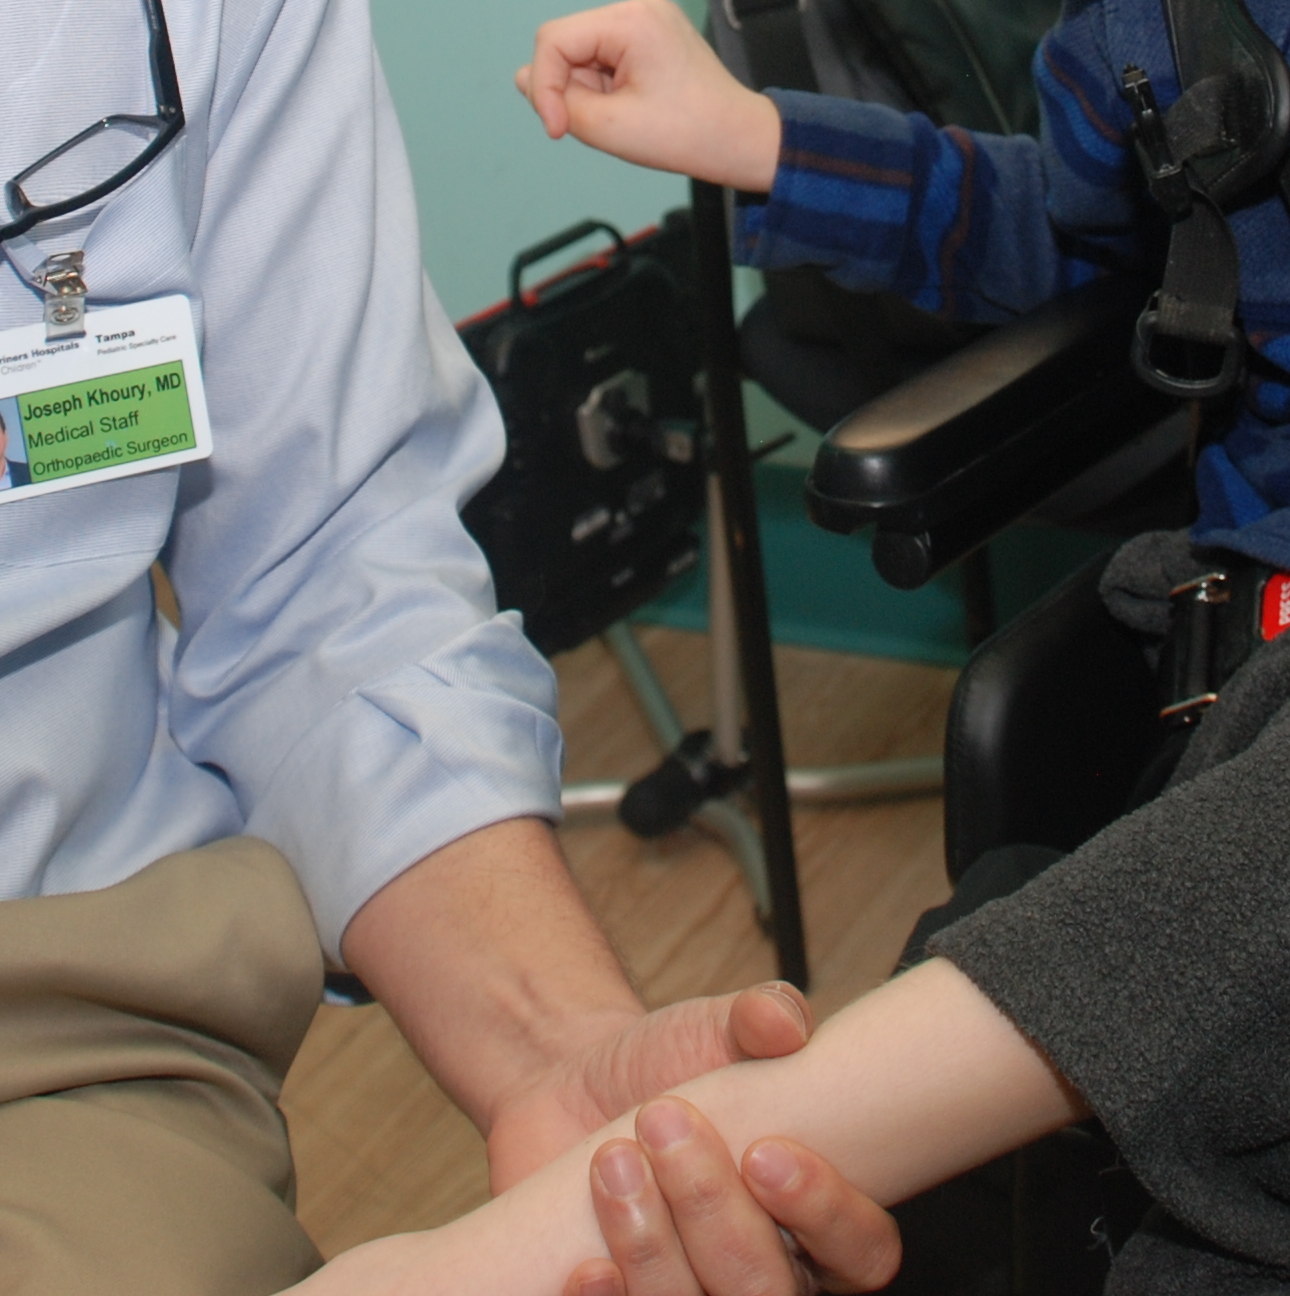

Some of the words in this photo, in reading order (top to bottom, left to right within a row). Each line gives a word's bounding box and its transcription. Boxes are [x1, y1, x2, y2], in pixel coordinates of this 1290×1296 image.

[31, 341, 80, 358] Hospitals
[95, 329, 136, 345] Tampa
[160, 334, 177, 344] Care
[23, 395, 83, 421] Joseph
[86, 383, 152, 406] Khoury,
[155, 372, 181, 393] MD
[27, 420, 94, 450] Medical
[99, 410, 140, 433] Staff
[32, 445, 124, 476] Orthopaedic
[126, 432, 188, 454] Surgeon
